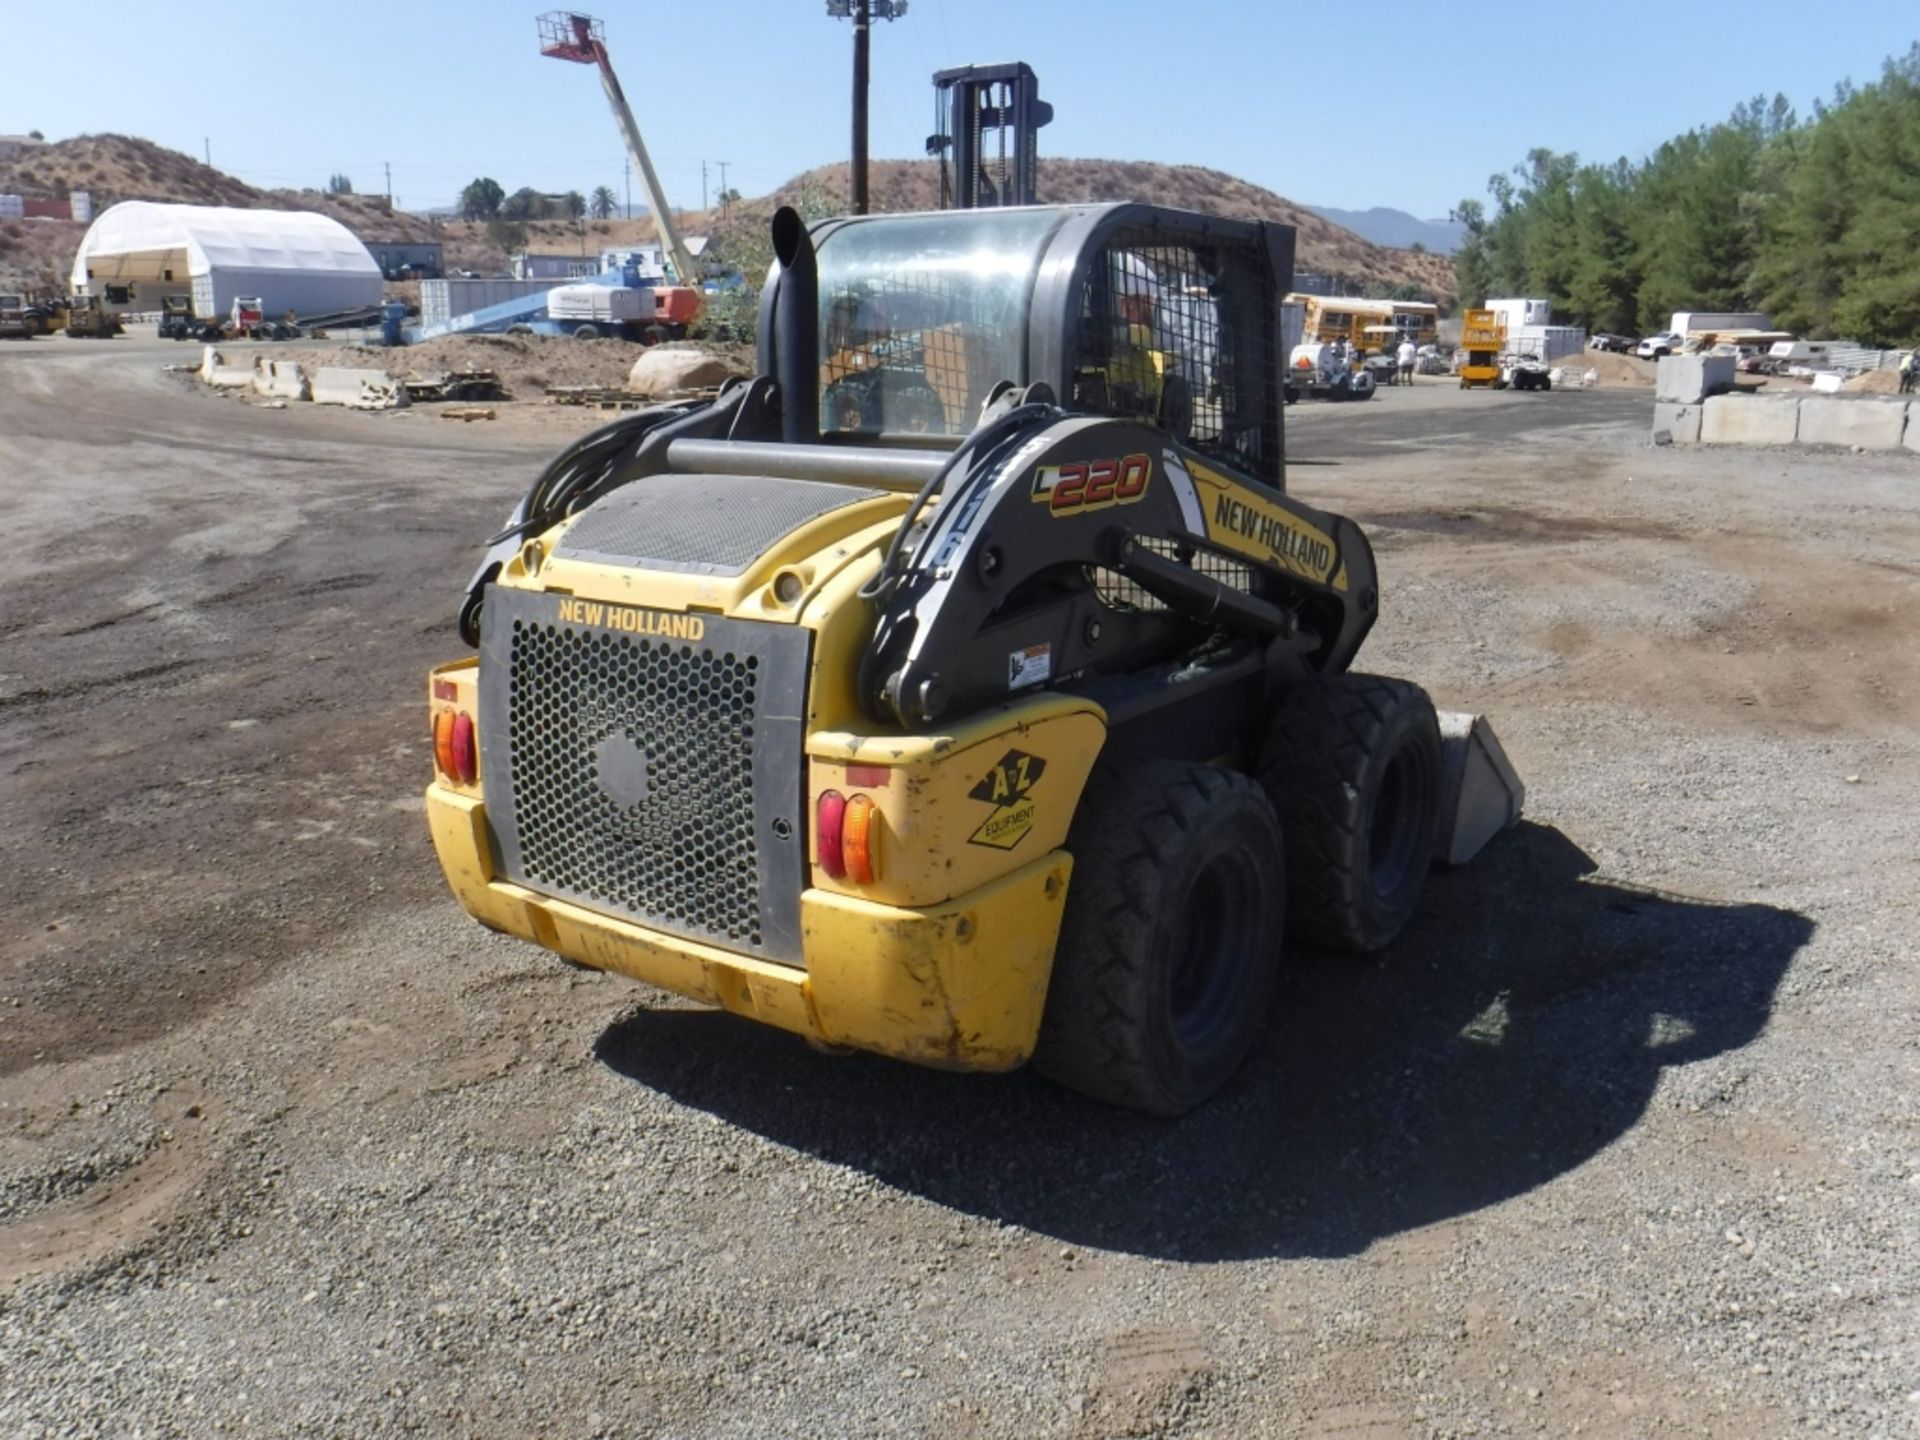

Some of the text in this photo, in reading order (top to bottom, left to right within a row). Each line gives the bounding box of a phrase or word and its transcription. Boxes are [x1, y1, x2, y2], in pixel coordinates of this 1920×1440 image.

[1034, 455, 1148, 510] L220
[1214, 493, 1329, 571] NEW HOLLAND
[558, 599, 705, 641] NEW HOLLAND
